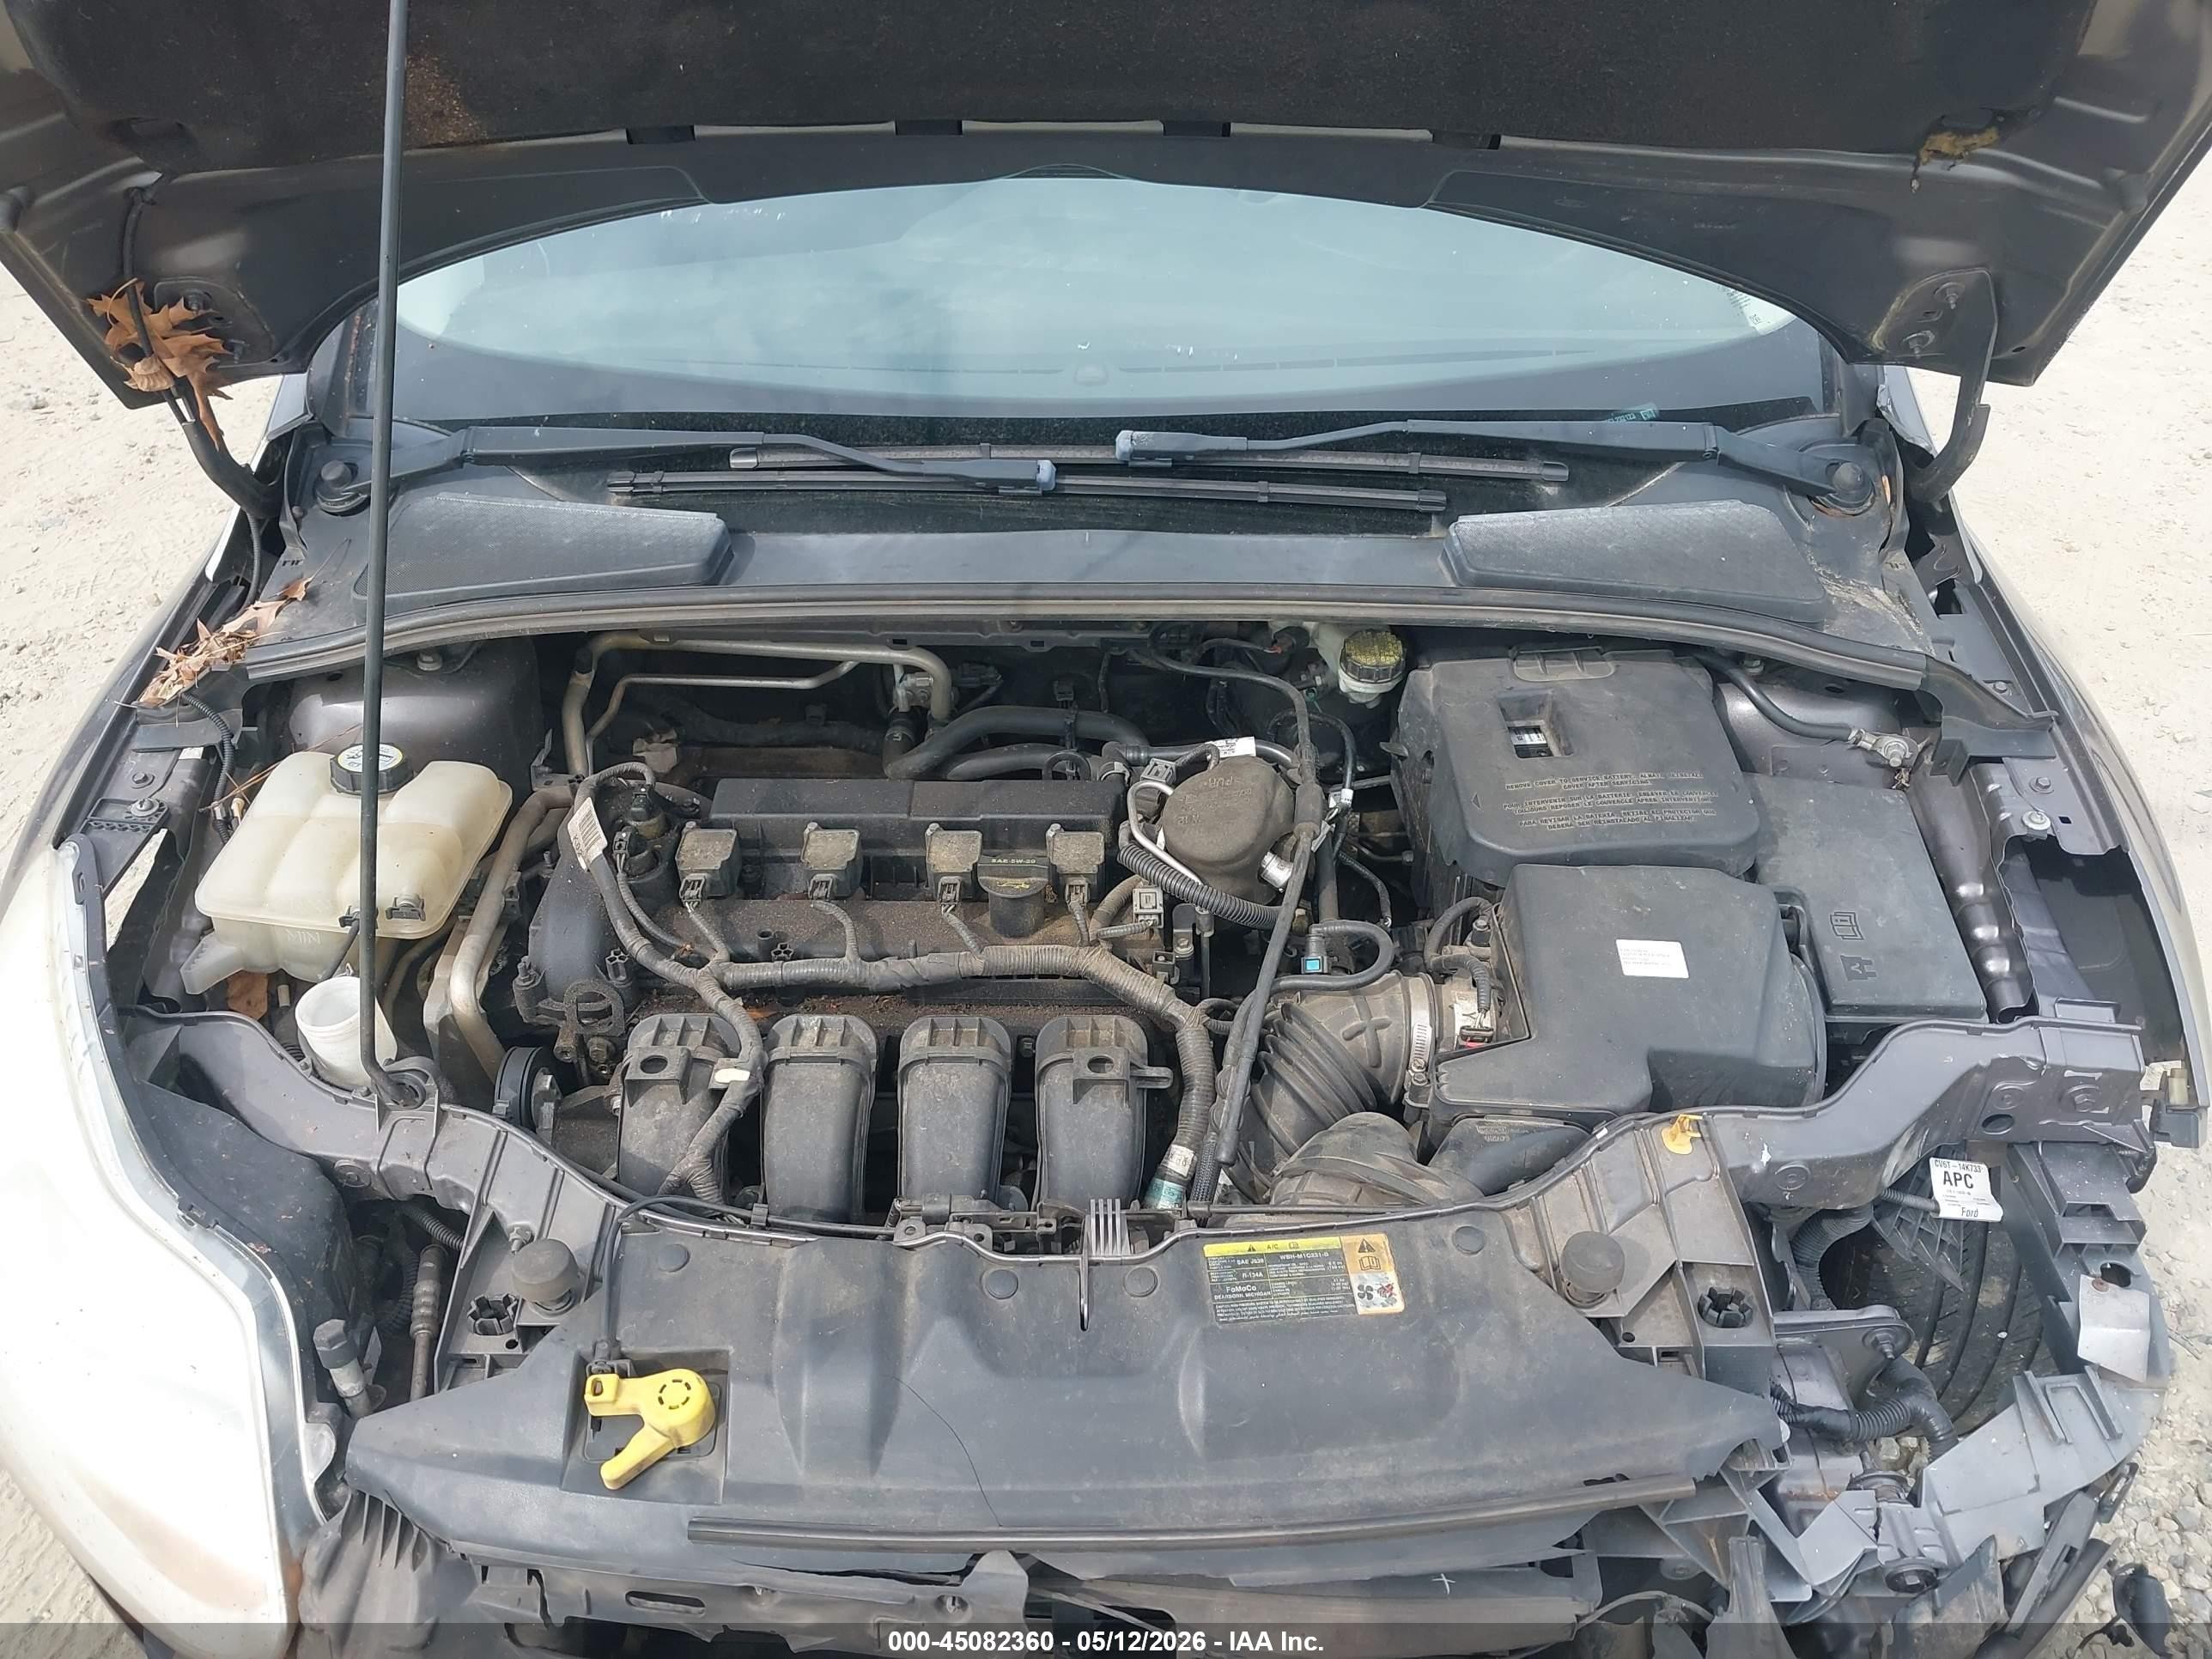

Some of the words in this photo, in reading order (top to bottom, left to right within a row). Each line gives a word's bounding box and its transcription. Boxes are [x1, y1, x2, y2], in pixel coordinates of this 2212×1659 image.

[1943, 1170, 1974, 1189] APC
[1961, 1206, 1978, 1218] Ford
[1226, 1285, 1256, 1293] FoMoCo
